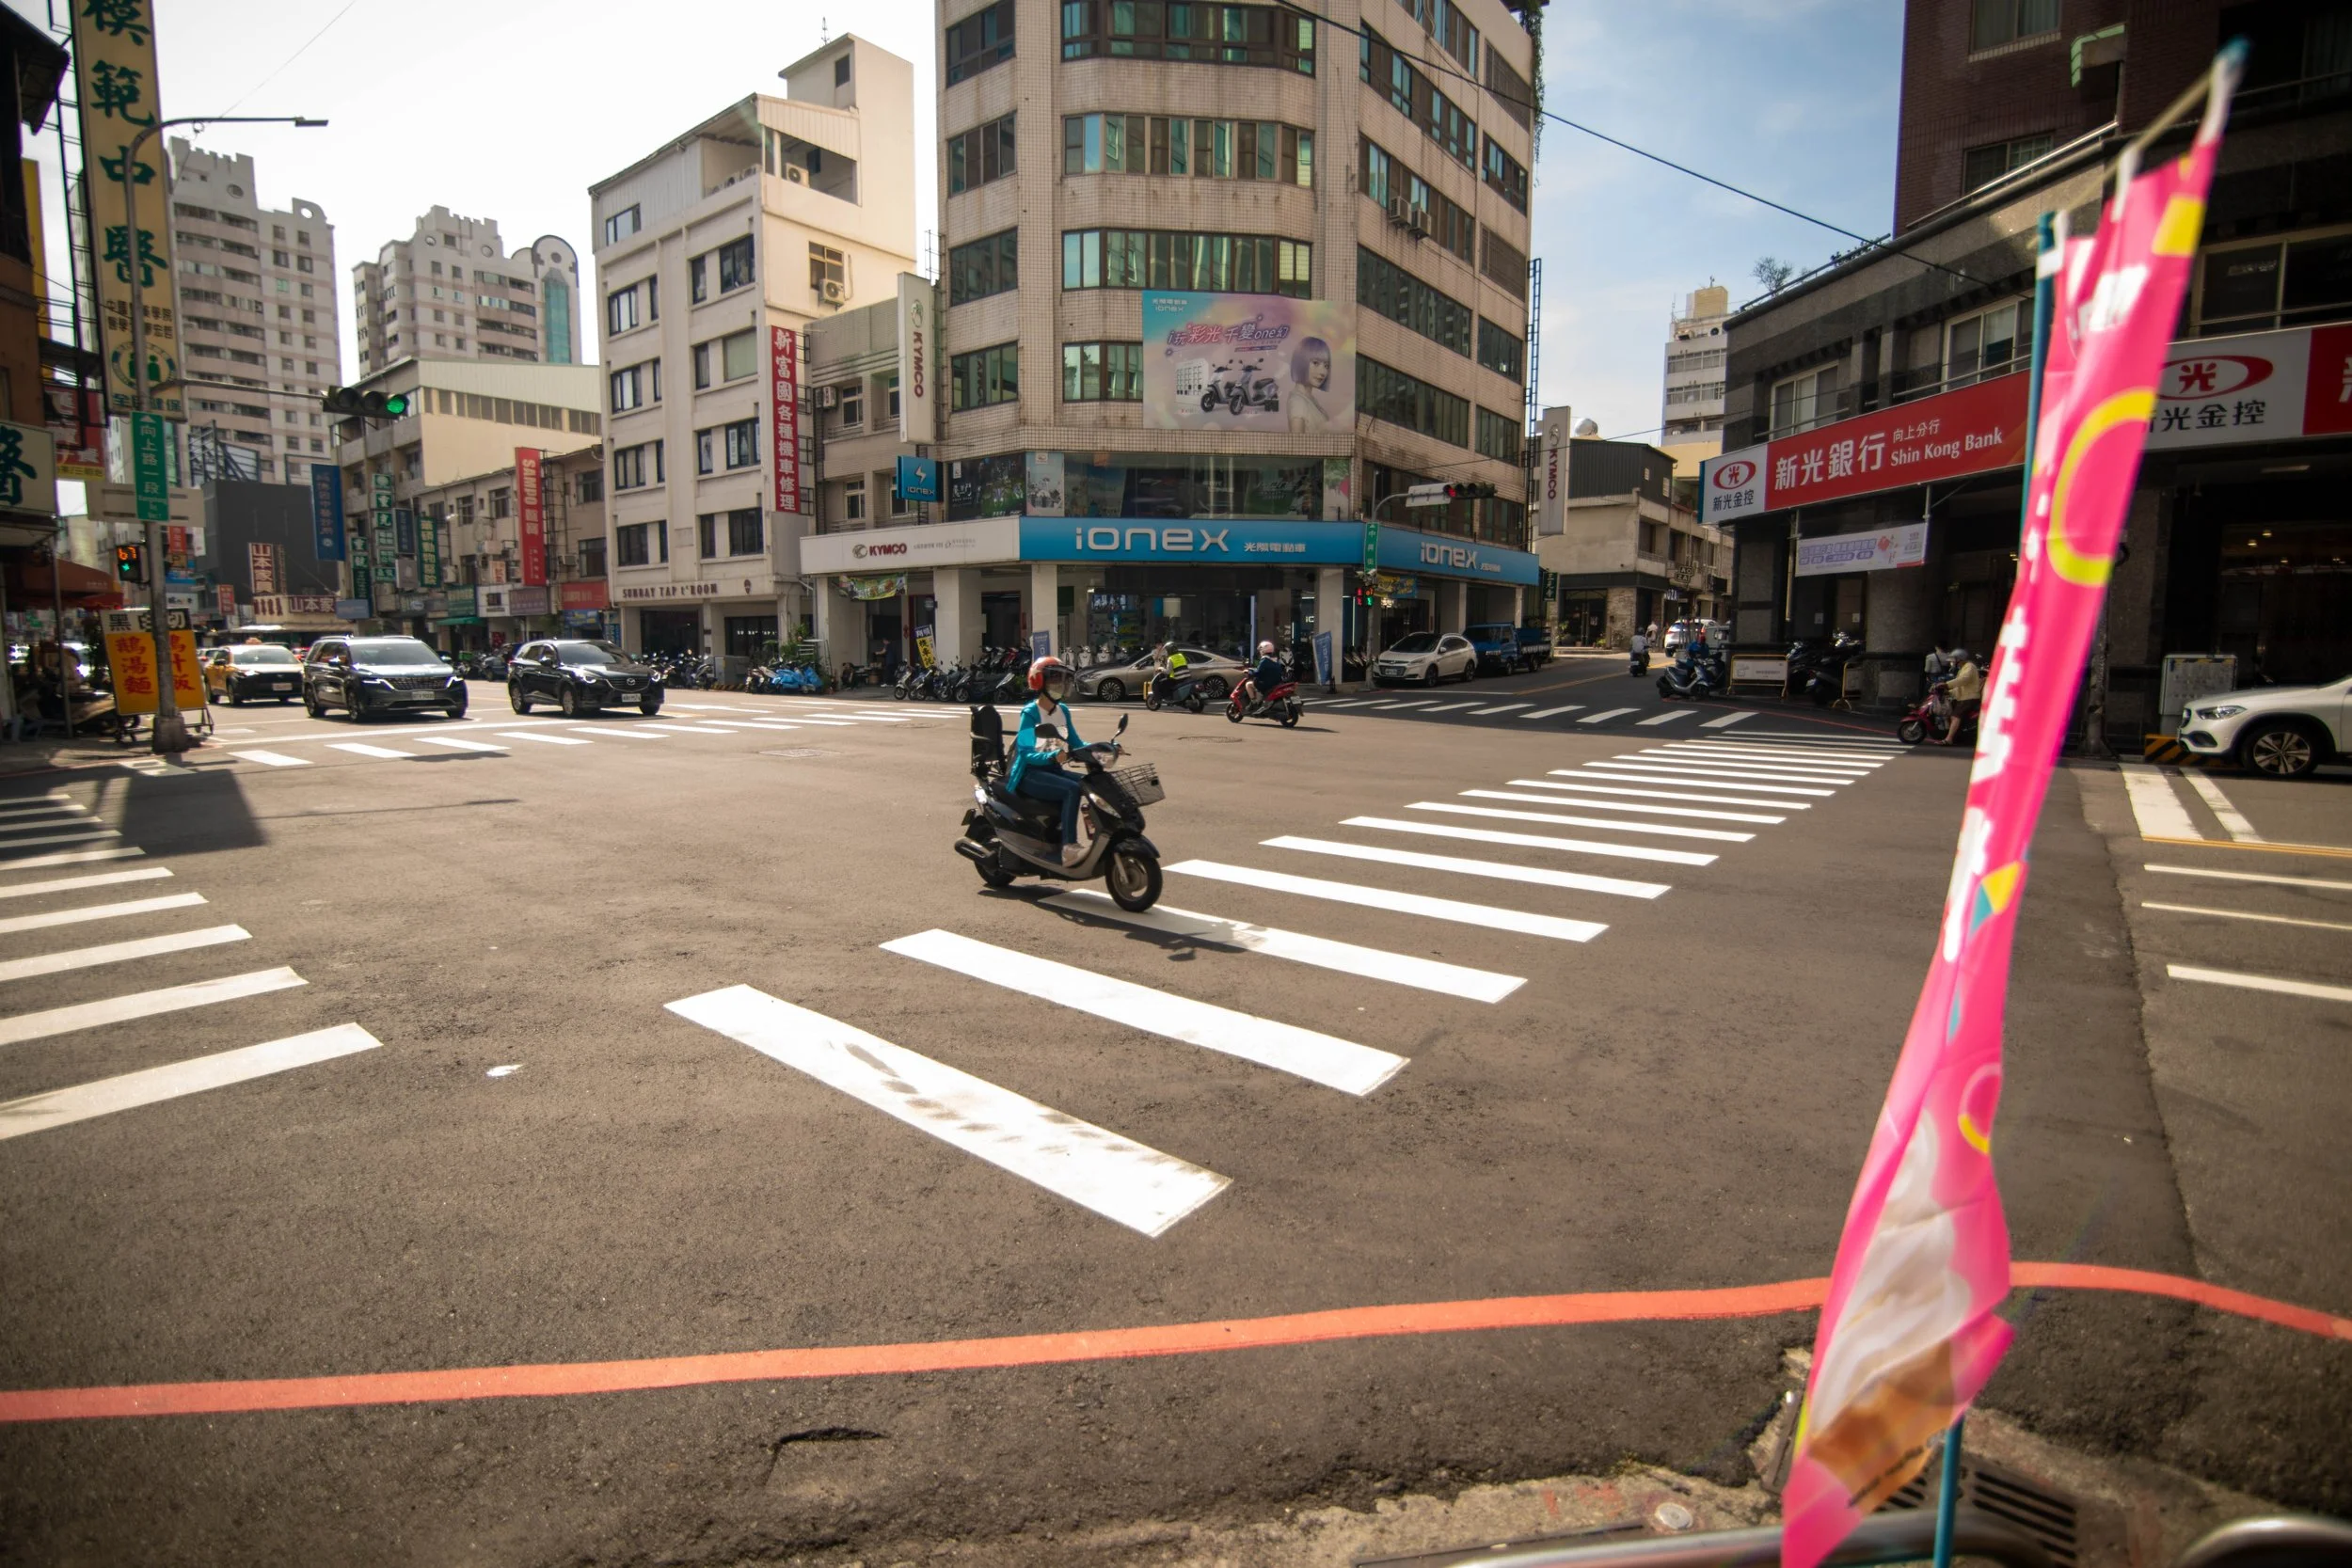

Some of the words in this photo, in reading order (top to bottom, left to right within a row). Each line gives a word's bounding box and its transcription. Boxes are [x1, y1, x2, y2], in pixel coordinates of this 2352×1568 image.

[913, 331, 924, 398] KYMCO
[774, 329, 796, 511] 新富國各種機車修理
[1892, 419, 1941, 442] 向上分行
[140, 425, 159, 495] 向上路一段
[1774, 432, 1885, 491] 新光銀行
[1890, 449, 1920, 467] Shin
[1924, 438, 1960, 461] Kong
[1964, 426, 2003, 451] Bank
[522, 459, 538, 505] SAMPO
[907, 486, 935, 496] ionex
[1548, 448, 1558, 500] KYMCO
[1712, 489, 1755, 512] 新光金控
[869, 543, 908, 556] KYMCO
[1075, 527, 1230, 552] ionex
[1421, 542, 1478, 569] ionex
